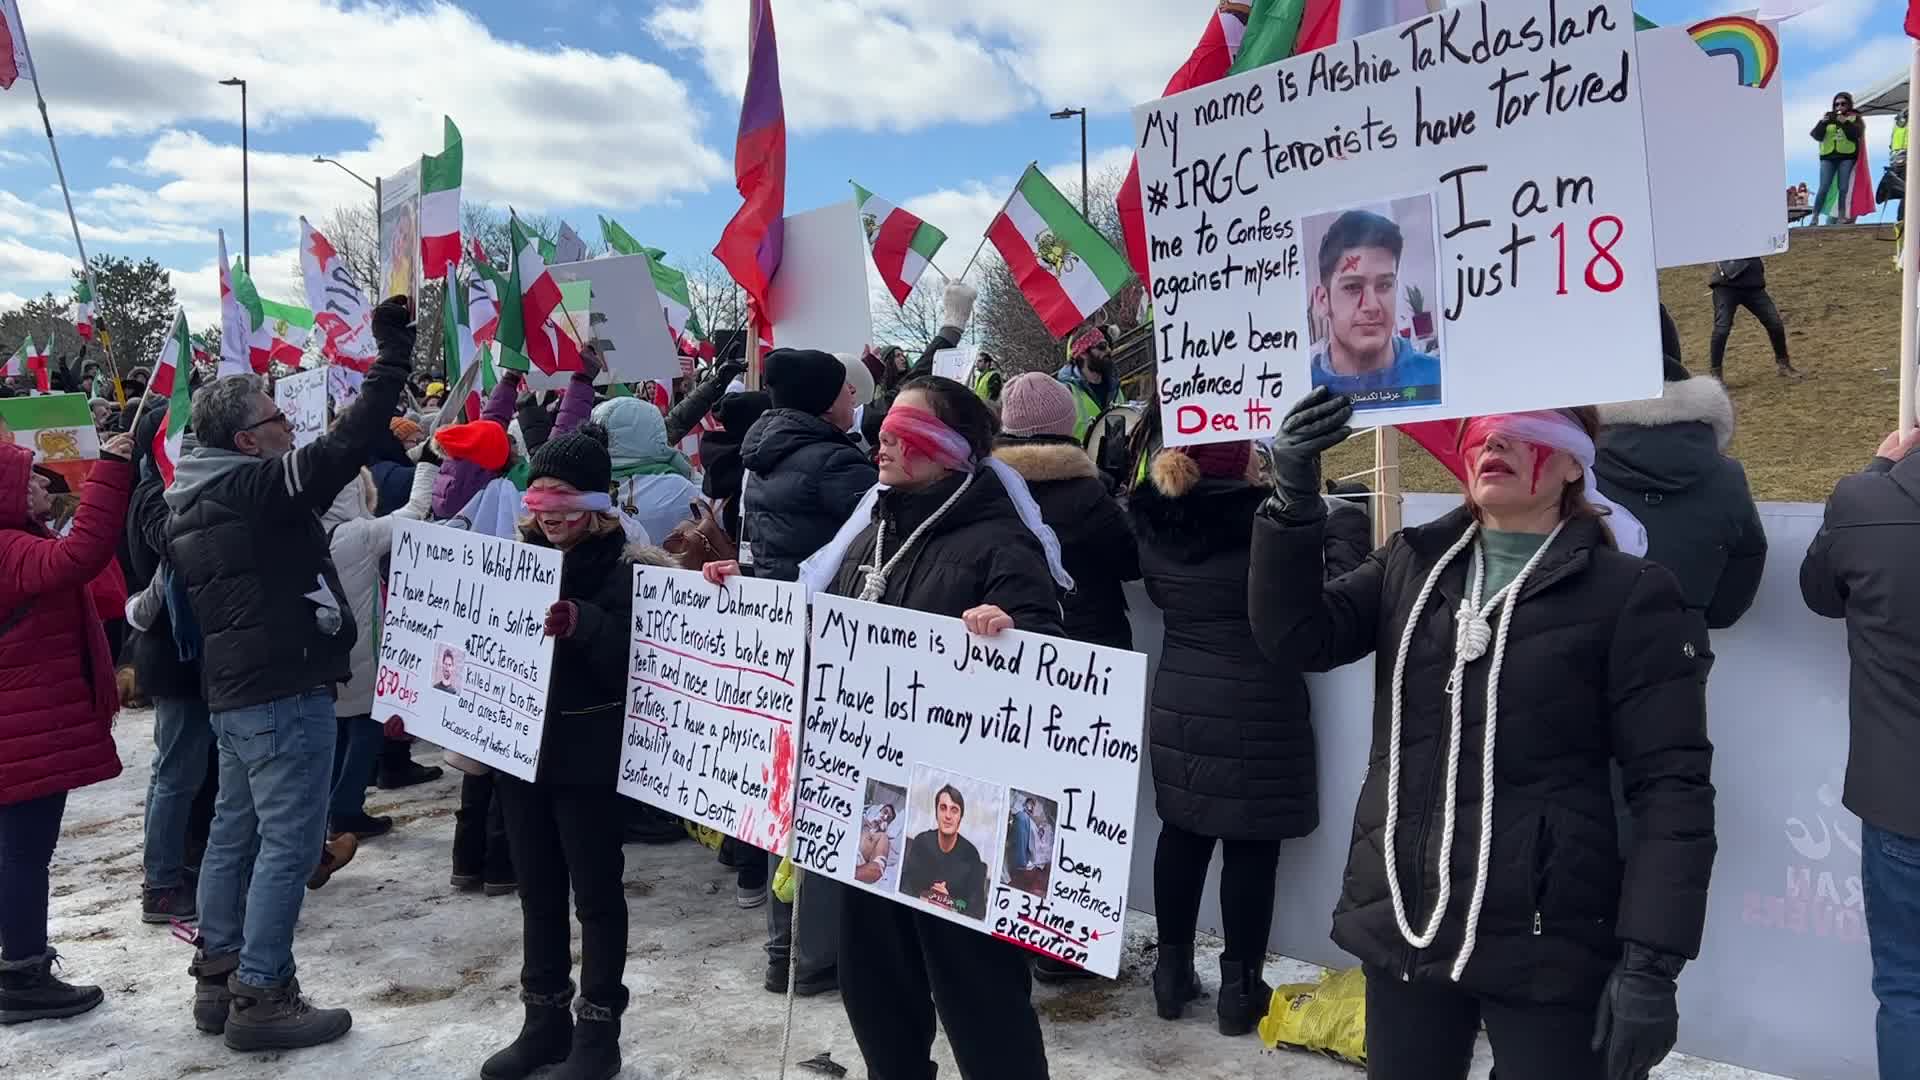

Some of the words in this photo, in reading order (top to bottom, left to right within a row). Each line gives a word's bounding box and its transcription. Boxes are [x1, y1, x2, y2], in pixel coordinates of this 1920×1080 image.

[1141, 112, 1178, 167] My
[1194, 83, 1264, 126] name
[1277, 69, 1298, 101] is
[1307, 40, 1400, 97] Arshia
[1147, 148, 1259, 214] #IRGC
[1264, 107, 1398, 181] terrorists
[1415, 86, 1476, 147] have
[1488, 50, 1630, 129] tortured
[1440, 164, 1491, 239] I
[1511, 175, 1594, 218] am
[1151, 229, 1184, 262] me
[1194, 210, 1218, 256] to
[1153, 254, 1243, 316] against
[1443, 222, 1536, 322] just
[1549, 214, 1624, 296] 18
[1160, 323, 1174, 363] I
[1181, 321, 1238, 360] have
[1247, 311, 1298, 352] been
[1256, 361, 1283, 399] to
[1176, 397, 1272, 435] Death
[397, 531, 421, 568] My
[426, 543, 455, 562] name
[462, 544, 474, 566] is
[481, 541, 515, 581] Vahid
[514, 550, 556, 585] Afkari
[391, 571, 402, 597] I
[403, 572, 424, 602] have
[426, 579, 450, 612] been
[452, 579, 484, 624] held
[488, 607, 500, 628] in
[662, 576, 711, 610] Mansour
[717, 583, 794, 625] Dahmardeh
[498, 644, 538, 682] terrorists
[635, 610, 678, 644] #IRGC
[681, 620, 727, 658] terrorists
[735, 629, 769, 667] broke
[775, 647, 794, 680] my
[820, 609, 858, 660] My
[867, 622, 917, 649] name
[929, 629, 946, 653] is
[954, 633, 1025, 676] Javad
[1036, 643, 1112, 696] Rouhi
[398, 674, 419, 708] days
[634, 647, 657, 674] teeth
[661, 656, 682, 687] and
[684, 671, 708, 695] nose
[458, 692, 476, 713] and
[478, 706, 513, 729] arrested
[515, 721, 529, 736] me
[493, 685, 506, 704] my
[510, 682, 543, 717] brother
[814, 663, 833, 702] I
[837, 668, 875, 714] have
[885, 666, 925, 723] lost
[927, 703, 974, 744] many
[981, 697, 1032, 748] vital
[1042, 704, 1139, 764] functions
[471, 725, 483, 744] of
[480, 736, 490, 753] my
[671, 700, 681, 728] I
[684, 703, 706, 737] have
[710, 726, 718, 738] a
[721, 721, 773, 757] physical
[807, 706, 823, 732] of
[820, 717, 838, 744] my
[840, 712, 871, 759] body
[877, 731, 904, 766] due
[628, 723, 671, 764] disability
[672, 743, 694, 772] and
[699, 744, 710, 778] I
[712, 751, 739, 790] have
[741, 765, 768, 800] been
[803, 742, 815, 767] to
[678, 778, 689, 807] to
[1060, 788, 1081, 831] I
[1087, 791, 1128, 845] have
[795, 808, 822, 839] done
[826, 820, 846, 850] by
[793, 836, 838, 873] IRGC
[1058, 838, 1102, 882] been
[1022, 895, 1031, 916] 3
[1053, 881, 1122, 923] sentenced
[995, 917, 1088, 963] execution
